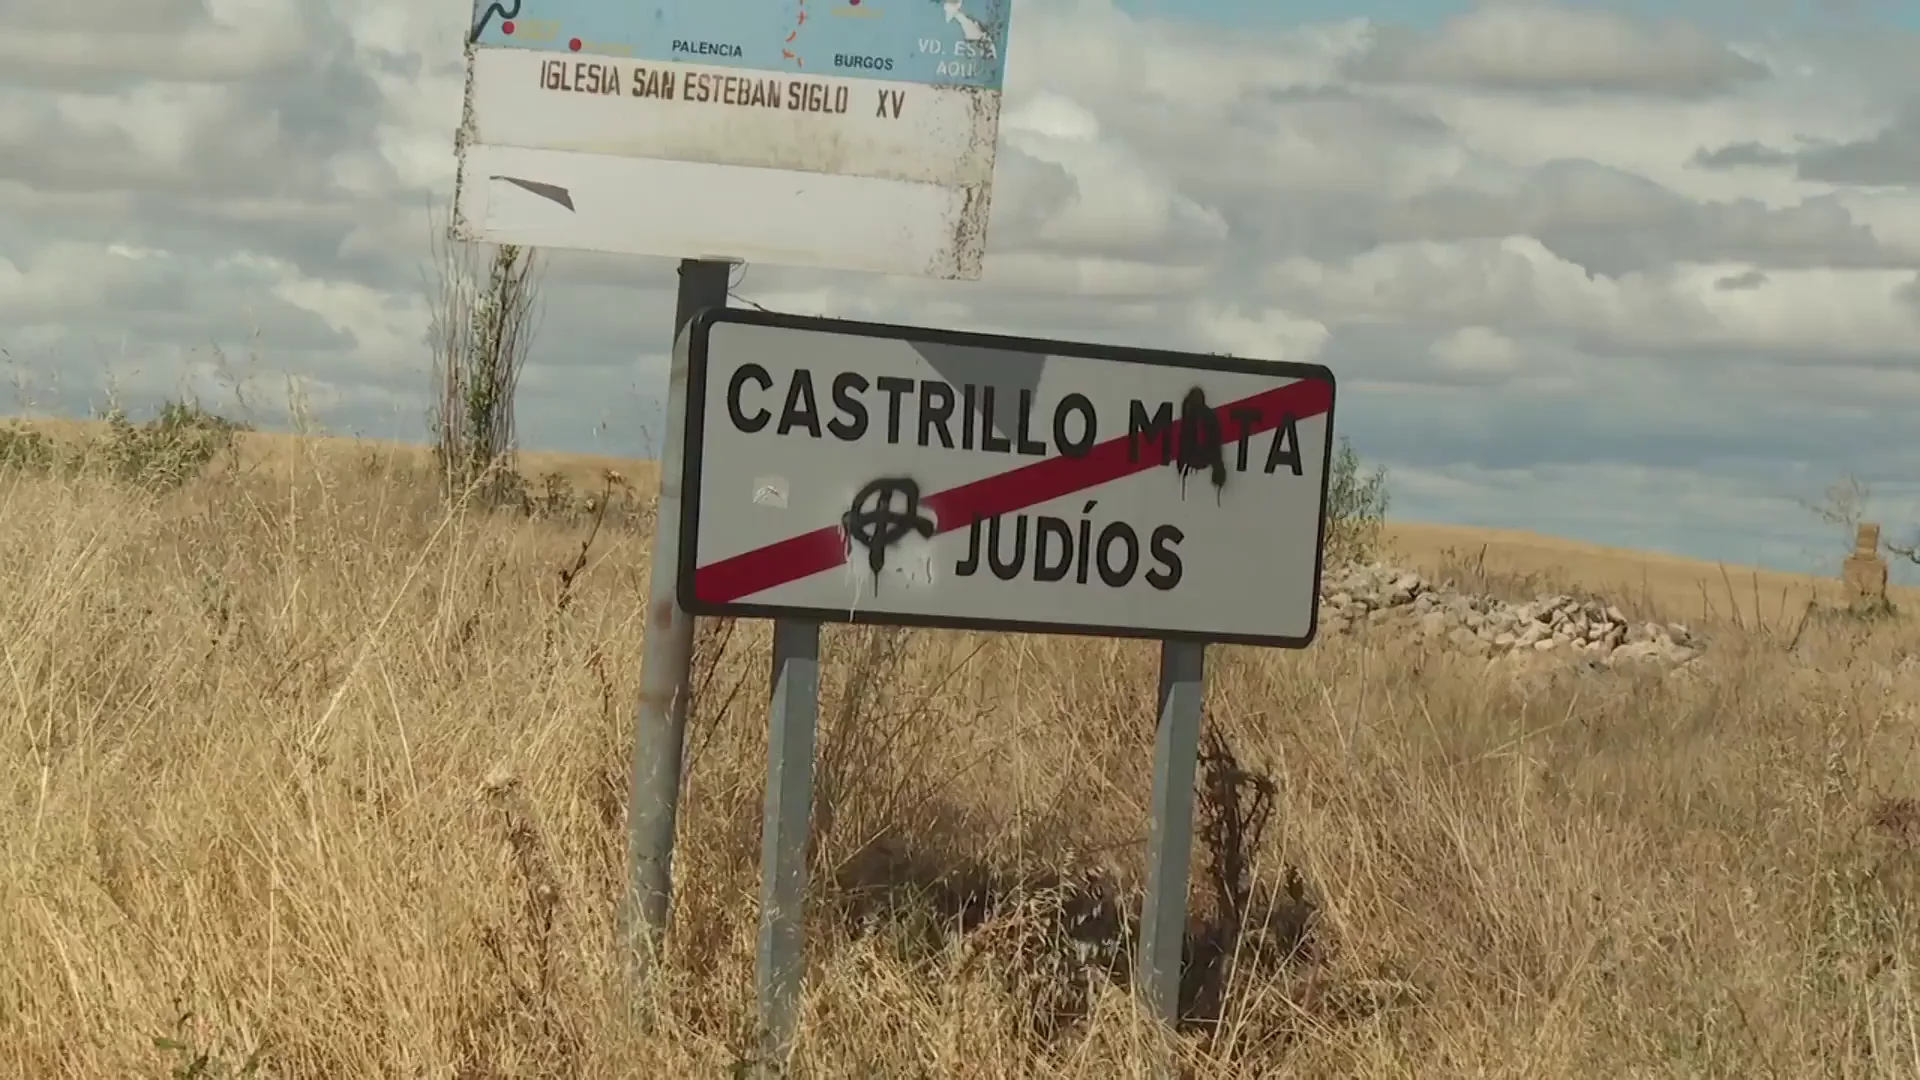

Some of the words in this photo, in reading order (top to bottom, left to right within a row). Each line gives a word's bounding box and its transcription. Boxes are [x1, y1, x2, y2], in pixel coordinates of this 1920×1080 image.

[672, 40, 743, 57] PALENCIA
[834, 54, 894, 70] BURGOS
[540, 60, 621, 95] IGLESIA
[632, 68, 675, 100] SAN
[683, 72, 781, 108] ESTEBAN
[788, 81, 849, 114] SIGLO
[876, 89, 905, 119] XV
[727, 363, 1097, 458] CASTRILLO
[956, 501, 1185, 591] JUDÍOS
